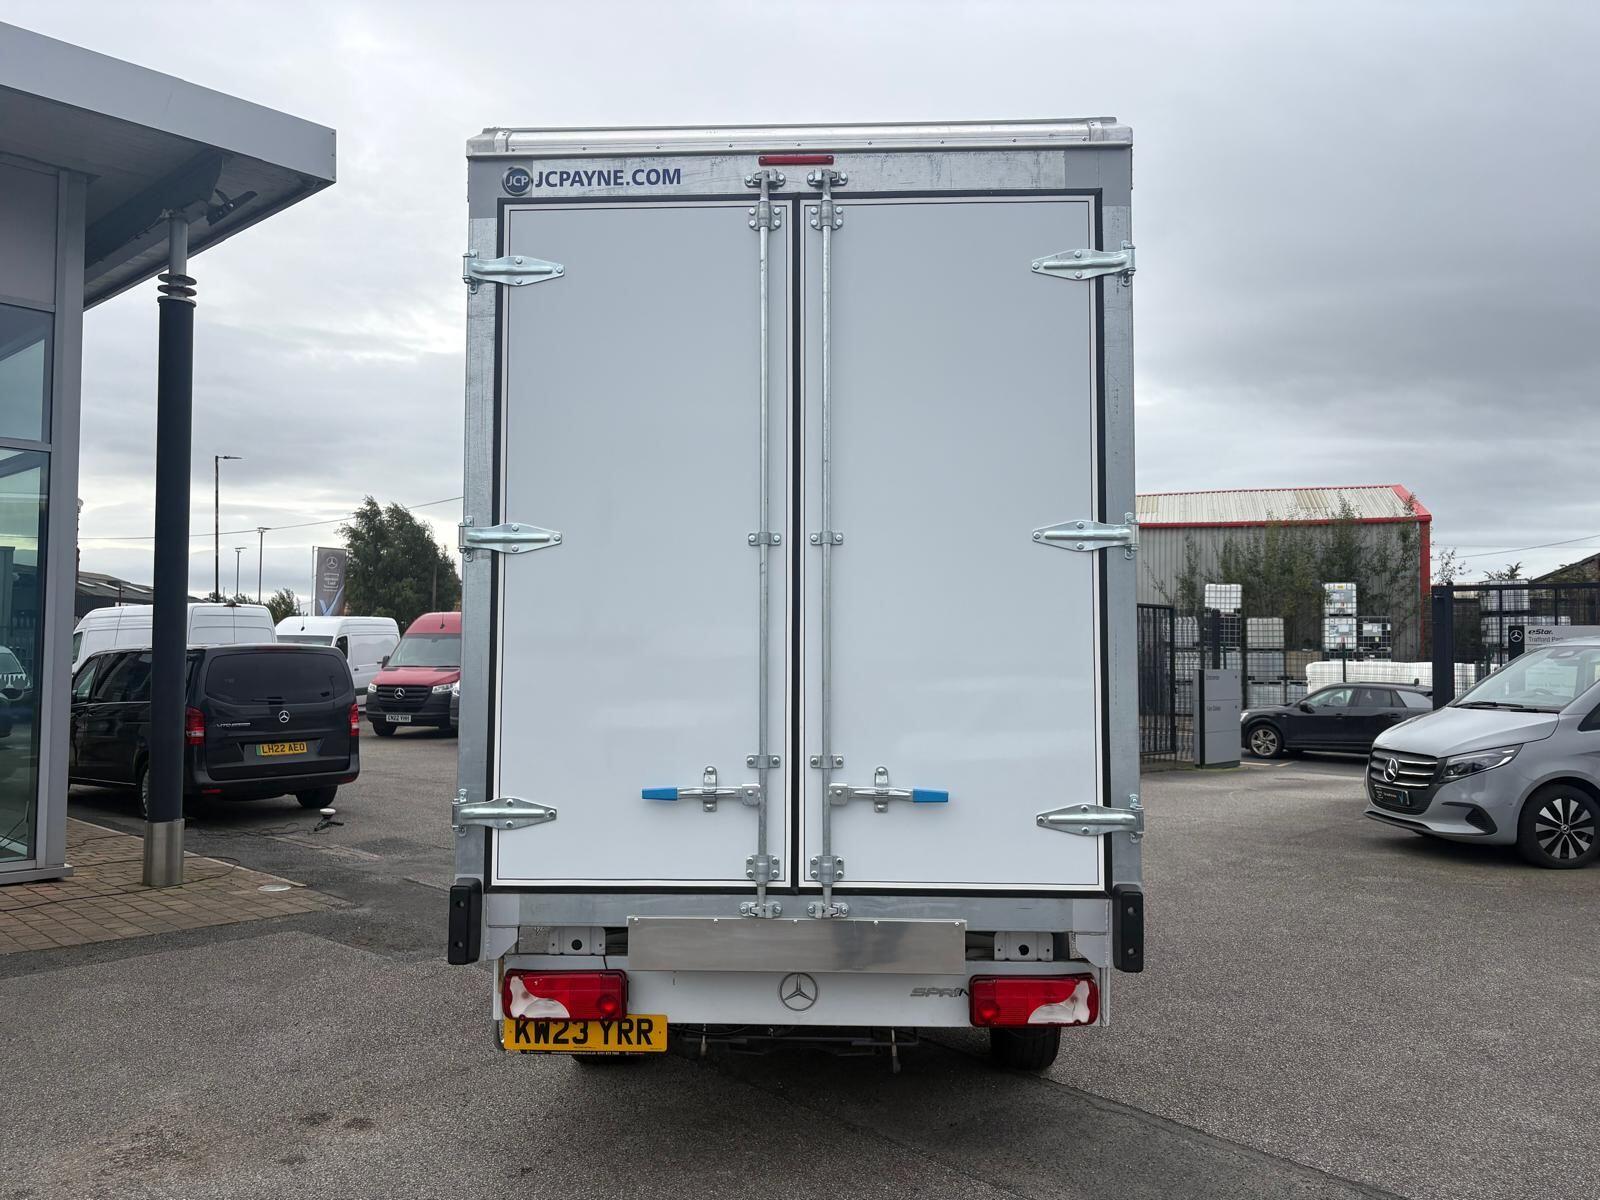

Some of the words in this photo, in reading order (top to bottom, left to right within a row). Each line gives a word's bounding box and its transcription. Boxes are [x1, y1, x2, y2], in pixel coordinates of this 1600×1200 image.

[507, 175, 529, 187] JCP
[535, 168, 681, 188] JCPAYNE.COM
[262, 744, 286, 754] LH22
[514, 1018, 589, 1045] KW23
[600, 1018, 654, 1046] YRR
